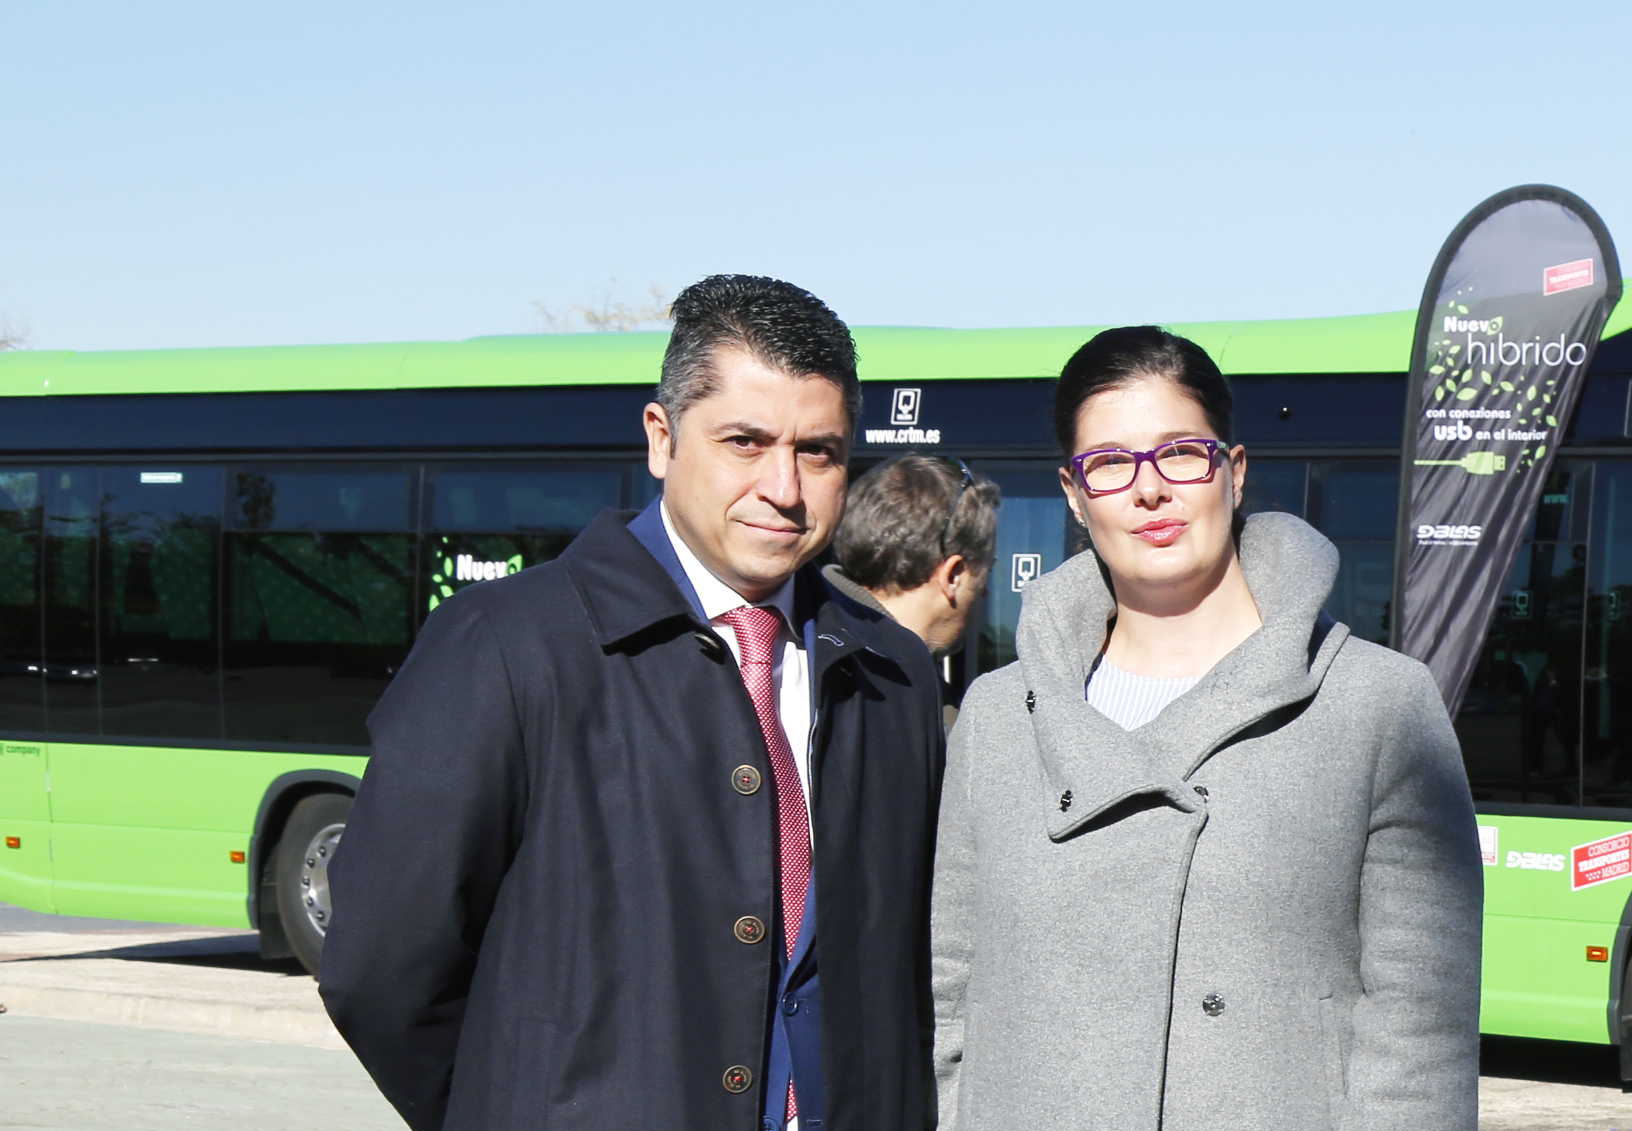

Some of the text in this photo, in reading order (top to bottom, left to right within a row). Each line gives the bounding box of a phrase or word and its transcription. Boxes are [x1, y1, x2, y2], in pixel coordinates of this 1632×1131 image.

[1444, 316, 1502, 333] Nuevo
[1426, 407, 1511, 419] con conexiones
[865, 426, 940, 444] www.crtm.es
[1434, 420, 1548, 441] usb en el interior
[1416, 525, 1481, 539] DBLAS
[1588, 837, 1630, 857] CONSORCIO
[1505, 850, 1566, 871] DBLAS
[1578, 849, 1630, 872] TRANSPORTES
[1601, 861, 1630, 878] MADRID
